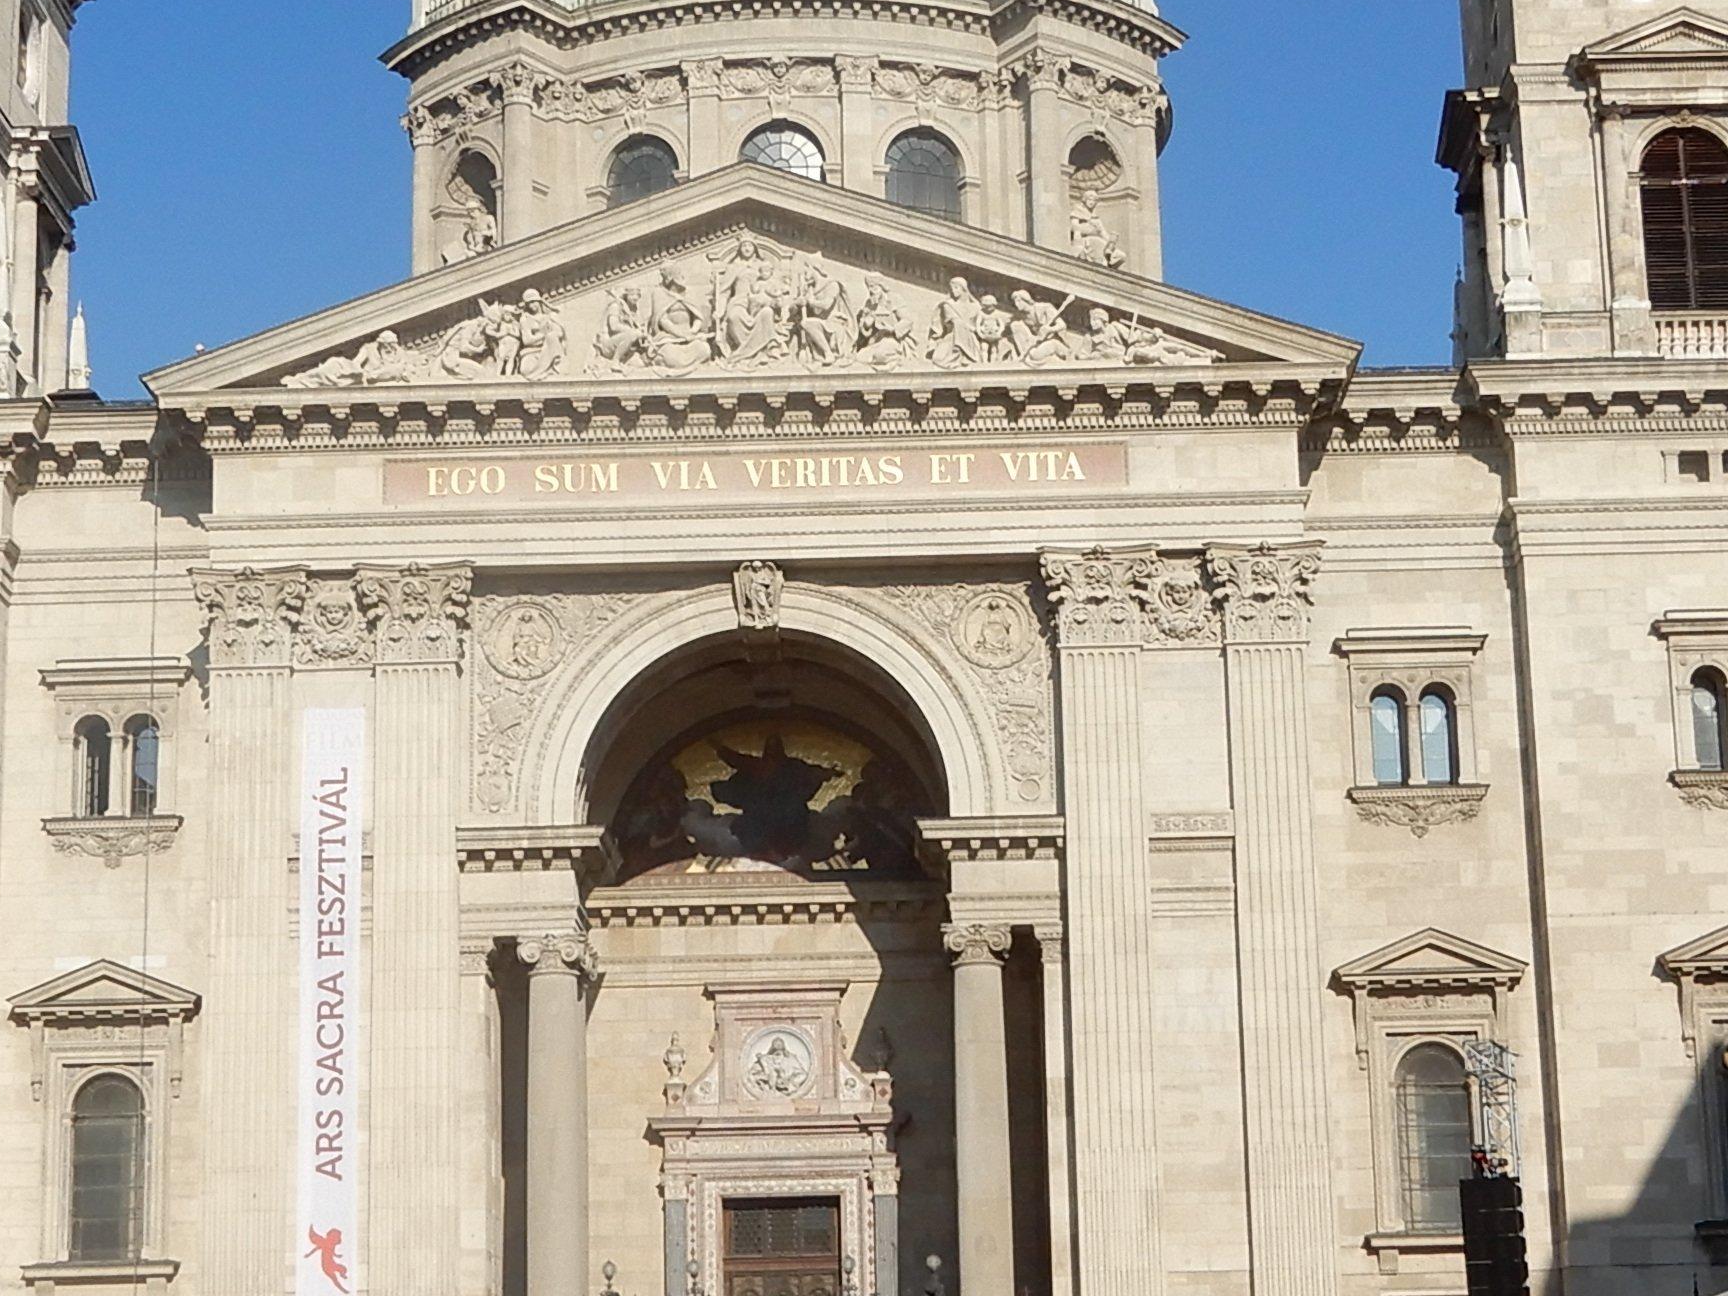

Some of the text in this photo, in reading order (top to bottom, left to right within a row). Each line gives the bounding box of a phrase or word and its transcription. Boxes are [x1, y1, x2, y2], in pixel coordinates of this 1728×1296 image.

[427, 451, 1086, 497] EGO SUM VIA VERITAS ET VITA
[312, 766, 349, 1182] ARS SACRA FESZTIVÁL
